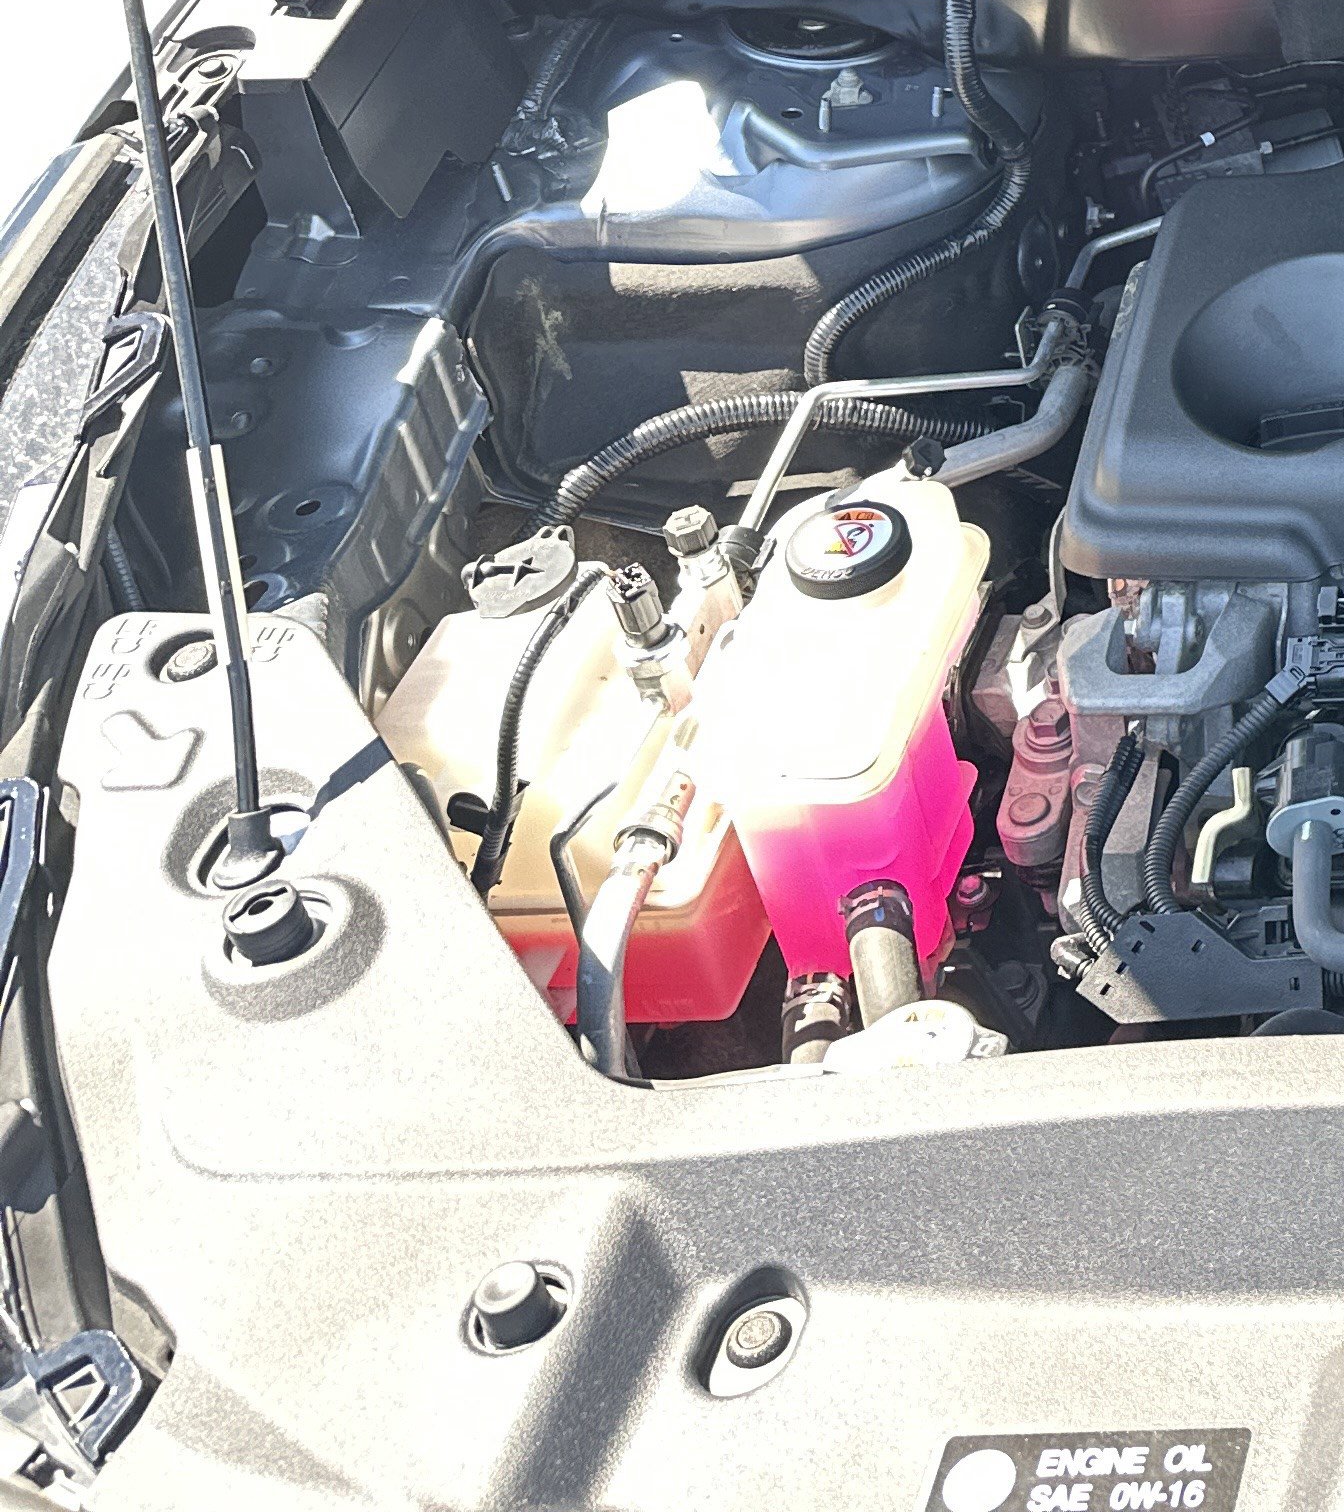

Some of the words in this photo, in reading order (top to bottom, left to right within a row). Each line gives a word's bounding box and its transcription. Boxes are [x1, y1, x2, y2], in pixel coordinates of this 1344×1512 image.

[1036, 1447, 1149, 1477] ENGINE
[1163, 1444, 1212, 1473] OIL
[1026, 1483, 1093, 1512] SAE
[1110, 1480, 1206, 1510] 0W-16
